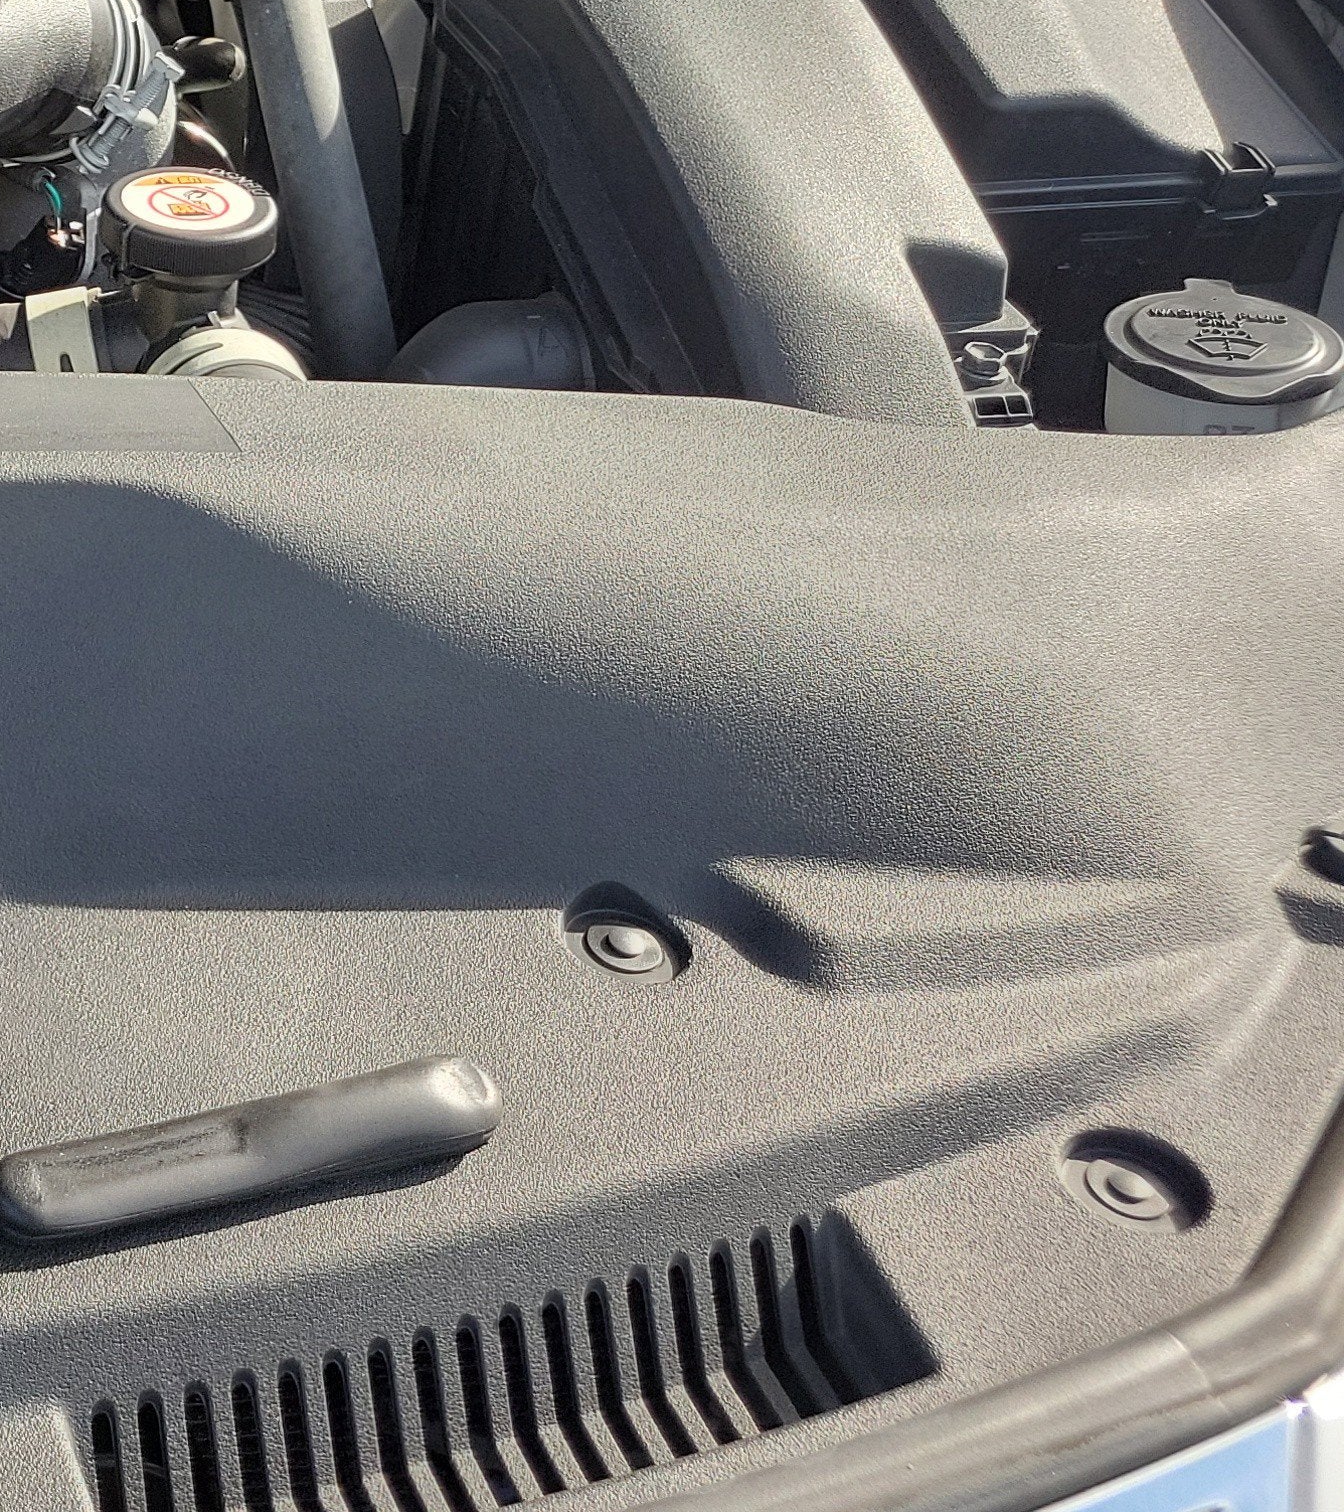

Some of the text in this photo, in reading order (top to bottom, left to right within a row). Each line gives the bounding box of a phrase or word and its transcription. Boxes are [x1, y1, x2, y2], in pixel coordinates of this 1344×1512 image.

[1147, 308, 1288, 325] WASHER FLUID
[1195, 317, 1244, 329] ONLY
